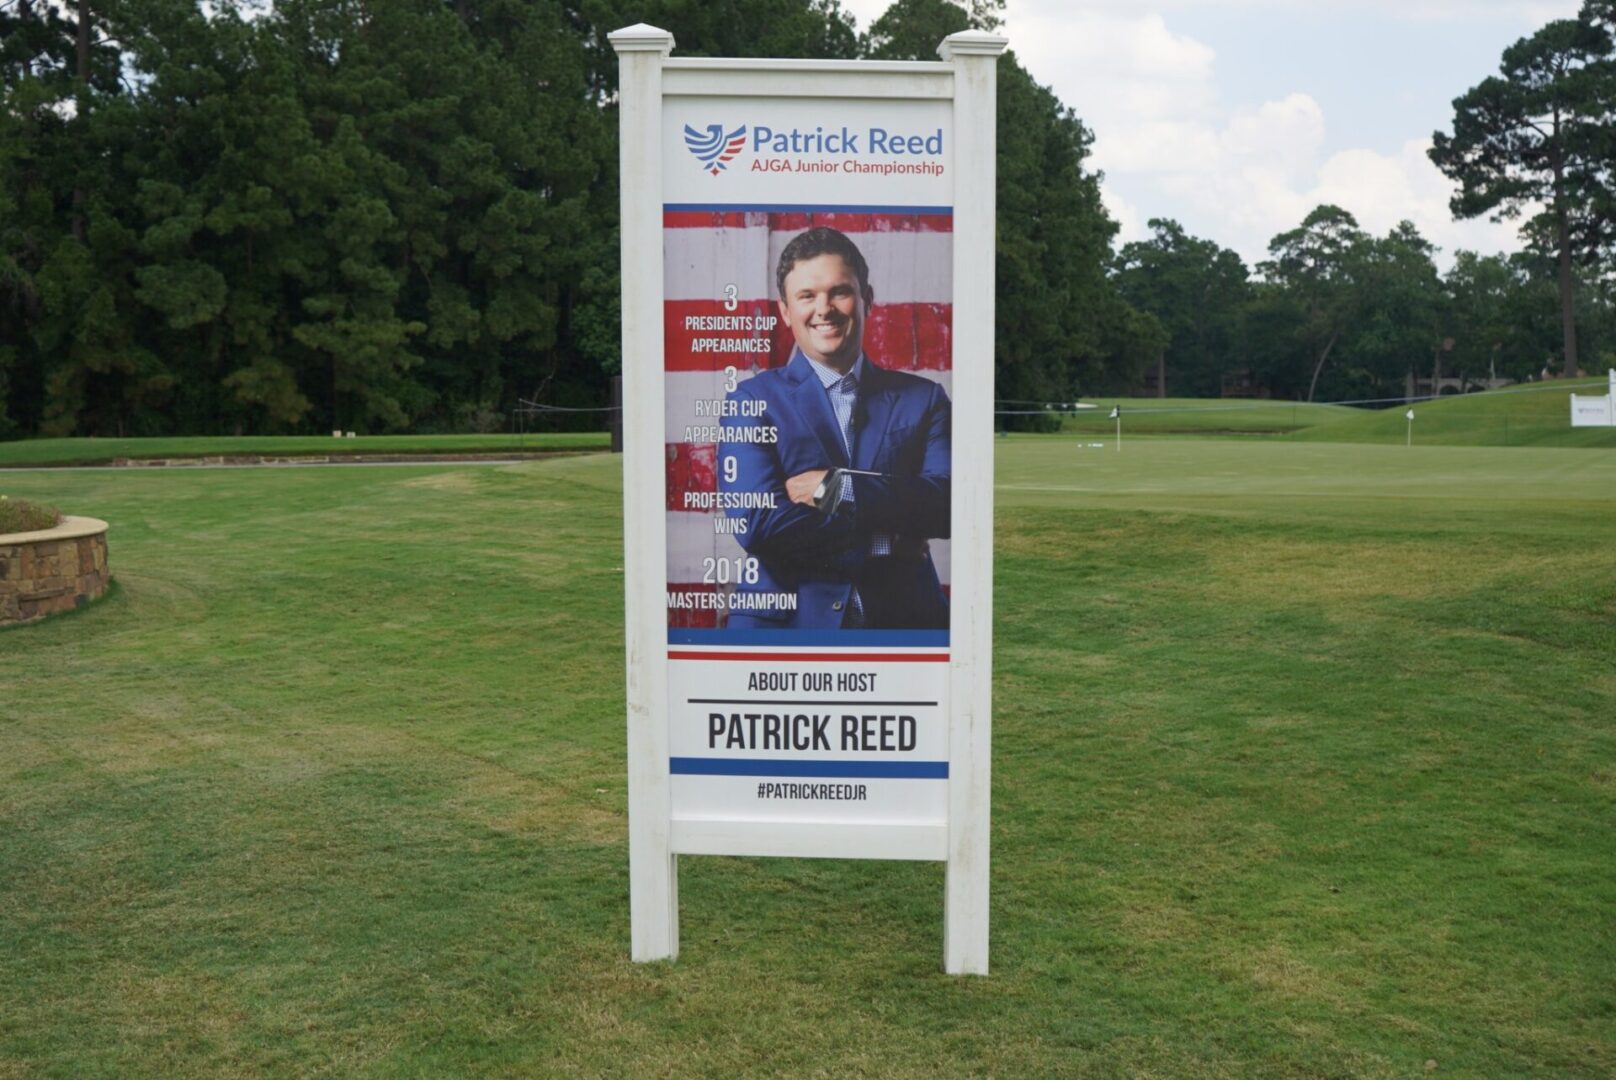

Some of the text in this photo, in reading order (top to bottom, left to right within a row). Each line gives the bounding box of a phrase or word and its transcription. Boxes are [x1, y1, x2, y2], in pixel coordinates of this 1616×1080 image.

[753, 126, 943, 155] Patrick Reed
[751, 159, 944, 176] AJGA Junior Championship
[724, 284, 738, 311] 3
[685, 316, 777, 331] PRESIDENTS CUP
[691, 338, 771, 353] APPEARANCES
[724, 366, 737, 392] 3
[695, 400, 767, 417] RYDER CUP
[684, 427, 778, 443] APPEARANCES
[723, 455, 738, 483] 9
[684, 492, 778, 509] PROFESSIONAL
[714, 518, 748, 534] WINS
[703, 557, 759, 584] 2018
[667, 592, 797, 610] MASTERS CHAMPION
[748, 672, 877, 692] ABOUT OUR HOST
[708, 713, 917, 751] PATRICK REED
[757, 782, 867, 800] #PATRICKREEDJR
